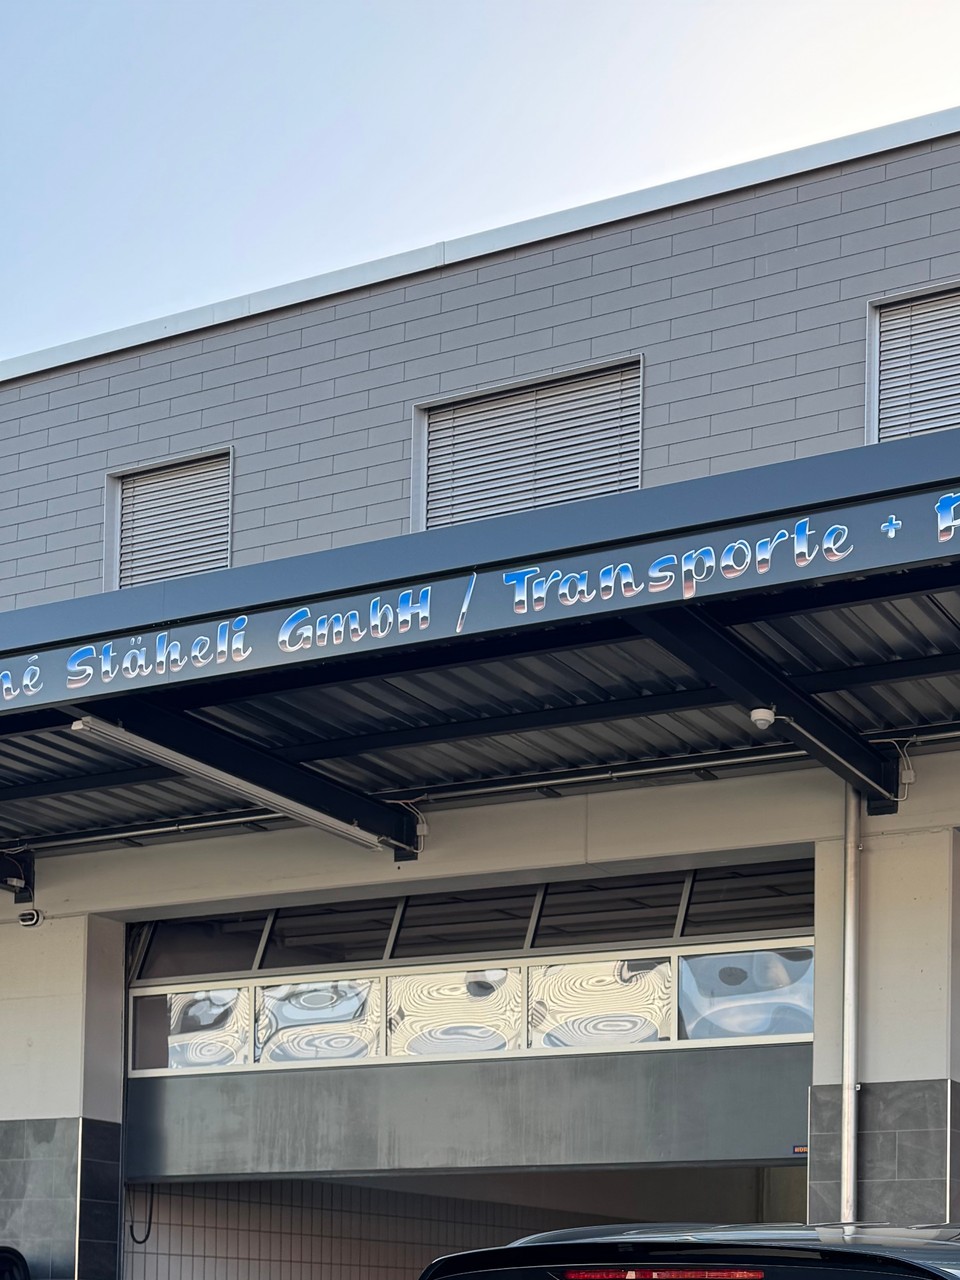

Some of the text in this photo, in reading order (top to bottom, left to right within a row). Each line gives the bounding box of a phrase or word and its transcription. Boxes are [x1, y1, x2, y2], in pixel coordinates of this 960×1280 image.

[65, 615, 252, 690] Stäheli
[277, 586, 432, 653] GmbH
[502, 516, 854, 614] Transporte
